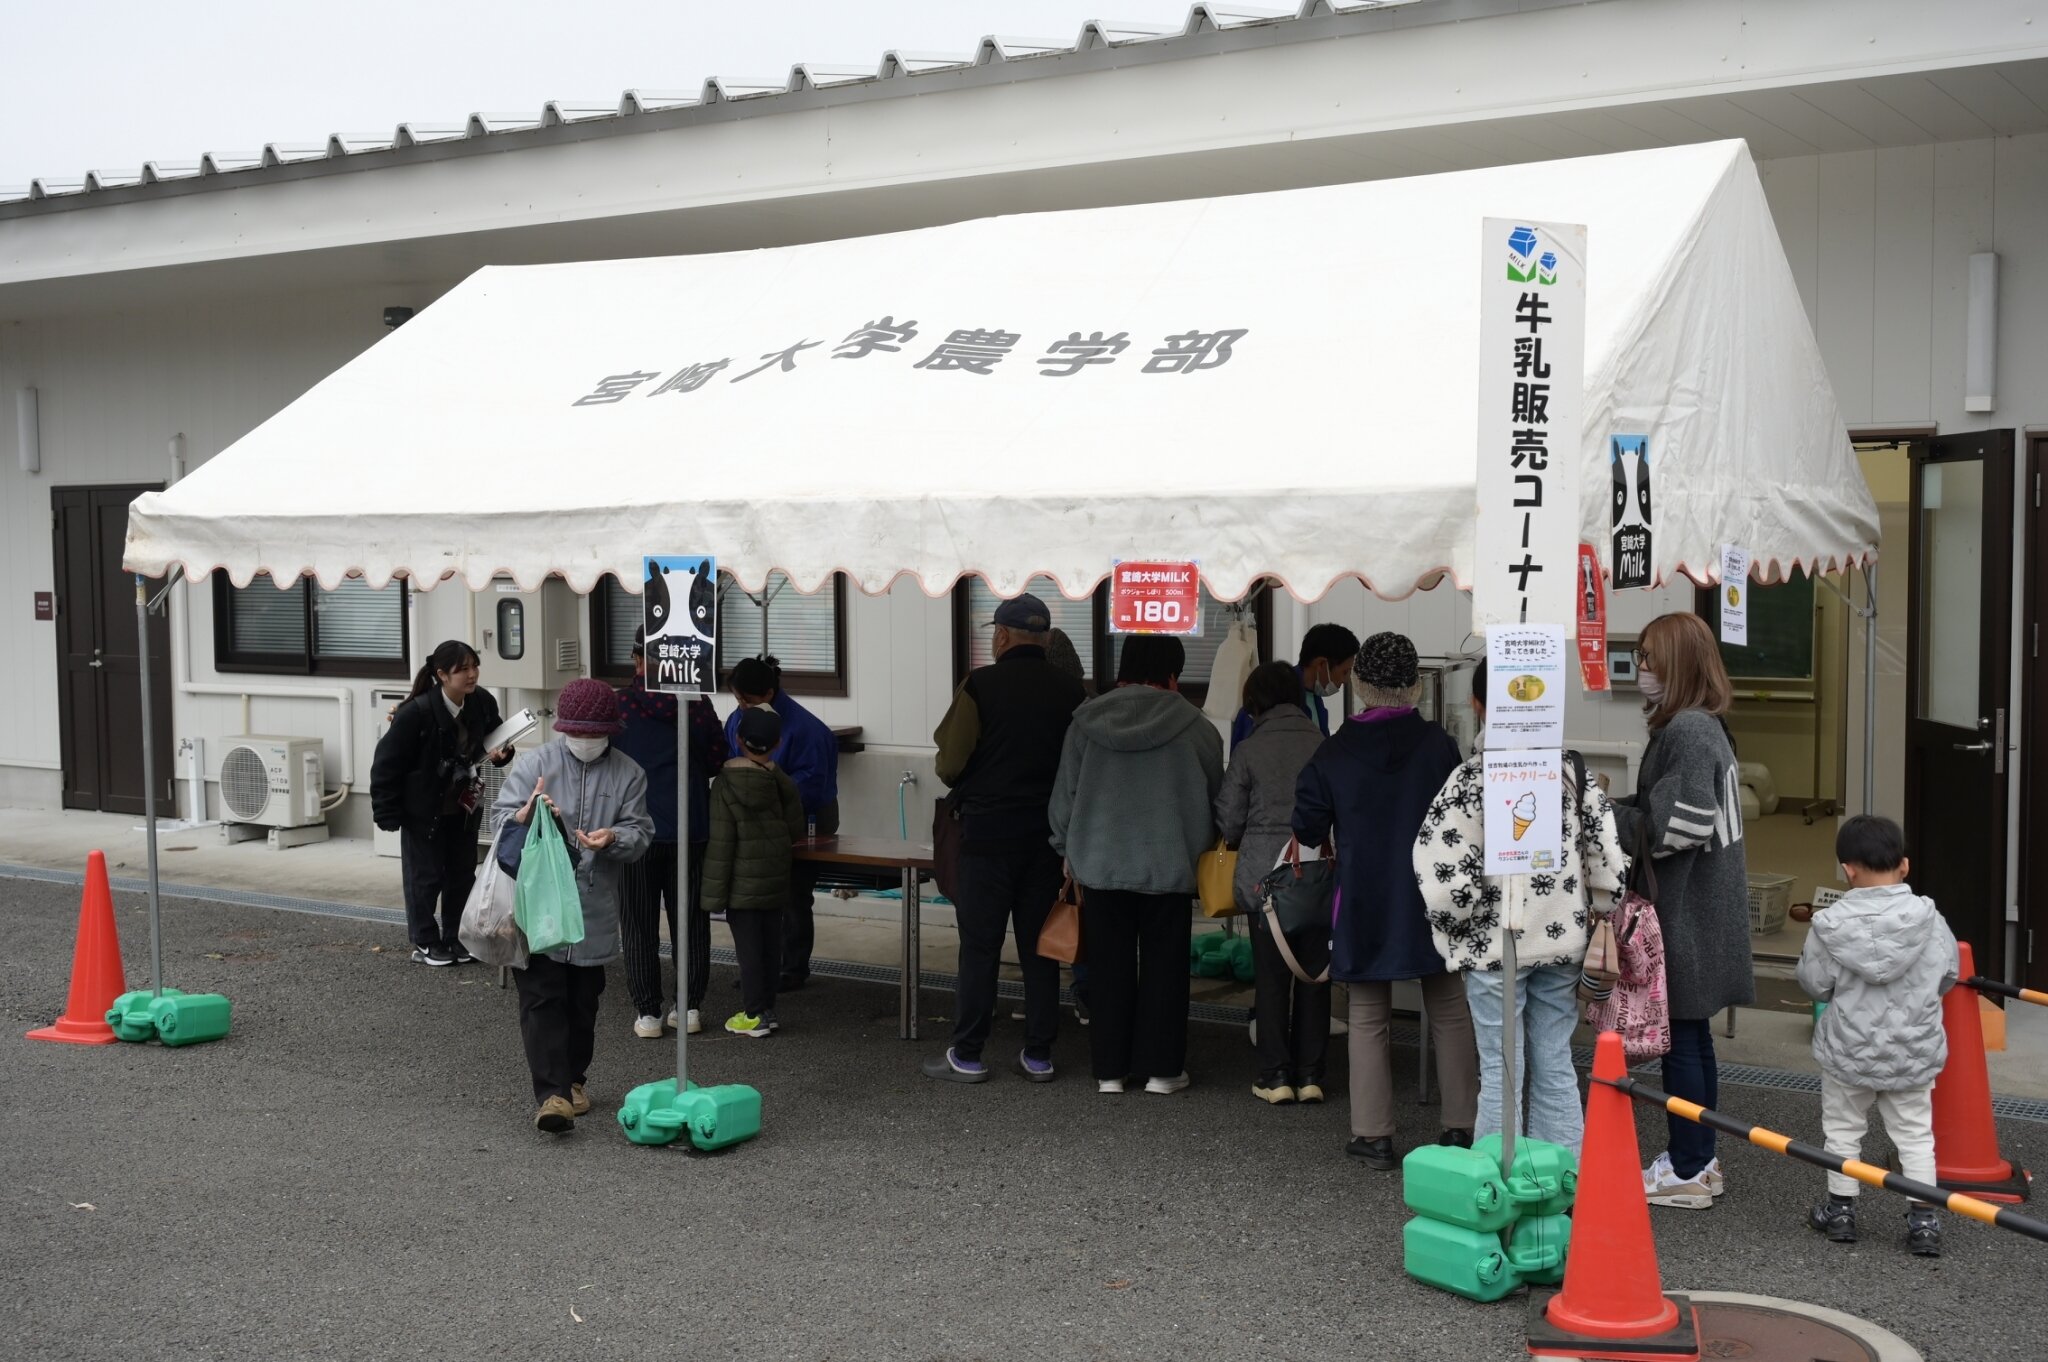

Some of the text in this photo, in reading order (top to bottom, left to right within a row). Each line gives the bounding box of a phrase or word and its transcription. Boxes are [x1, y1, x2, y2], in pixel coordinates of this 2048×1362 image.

[1508, 252, 1527, 271] MILK
[571, 315, 1249, 407] 宮崎大学農学部
[1510, 291, 1553, 625] 牛乳販売コーナー
[1620, 533, 1646, 551] 宮崎大学
[1619, 551, 1646, 580] Milk
[1121, 571, 1191, 583] 宮崎大学MILK
[1165, 588, 1184, 596] 500ml
[1133, 600, 1181, 623] 180
[658, 643, 702, 659] 宮崎大学
[658, 659, 702, 684] Milk
[1488, 770, 1558, 783] ソフトクリーム
